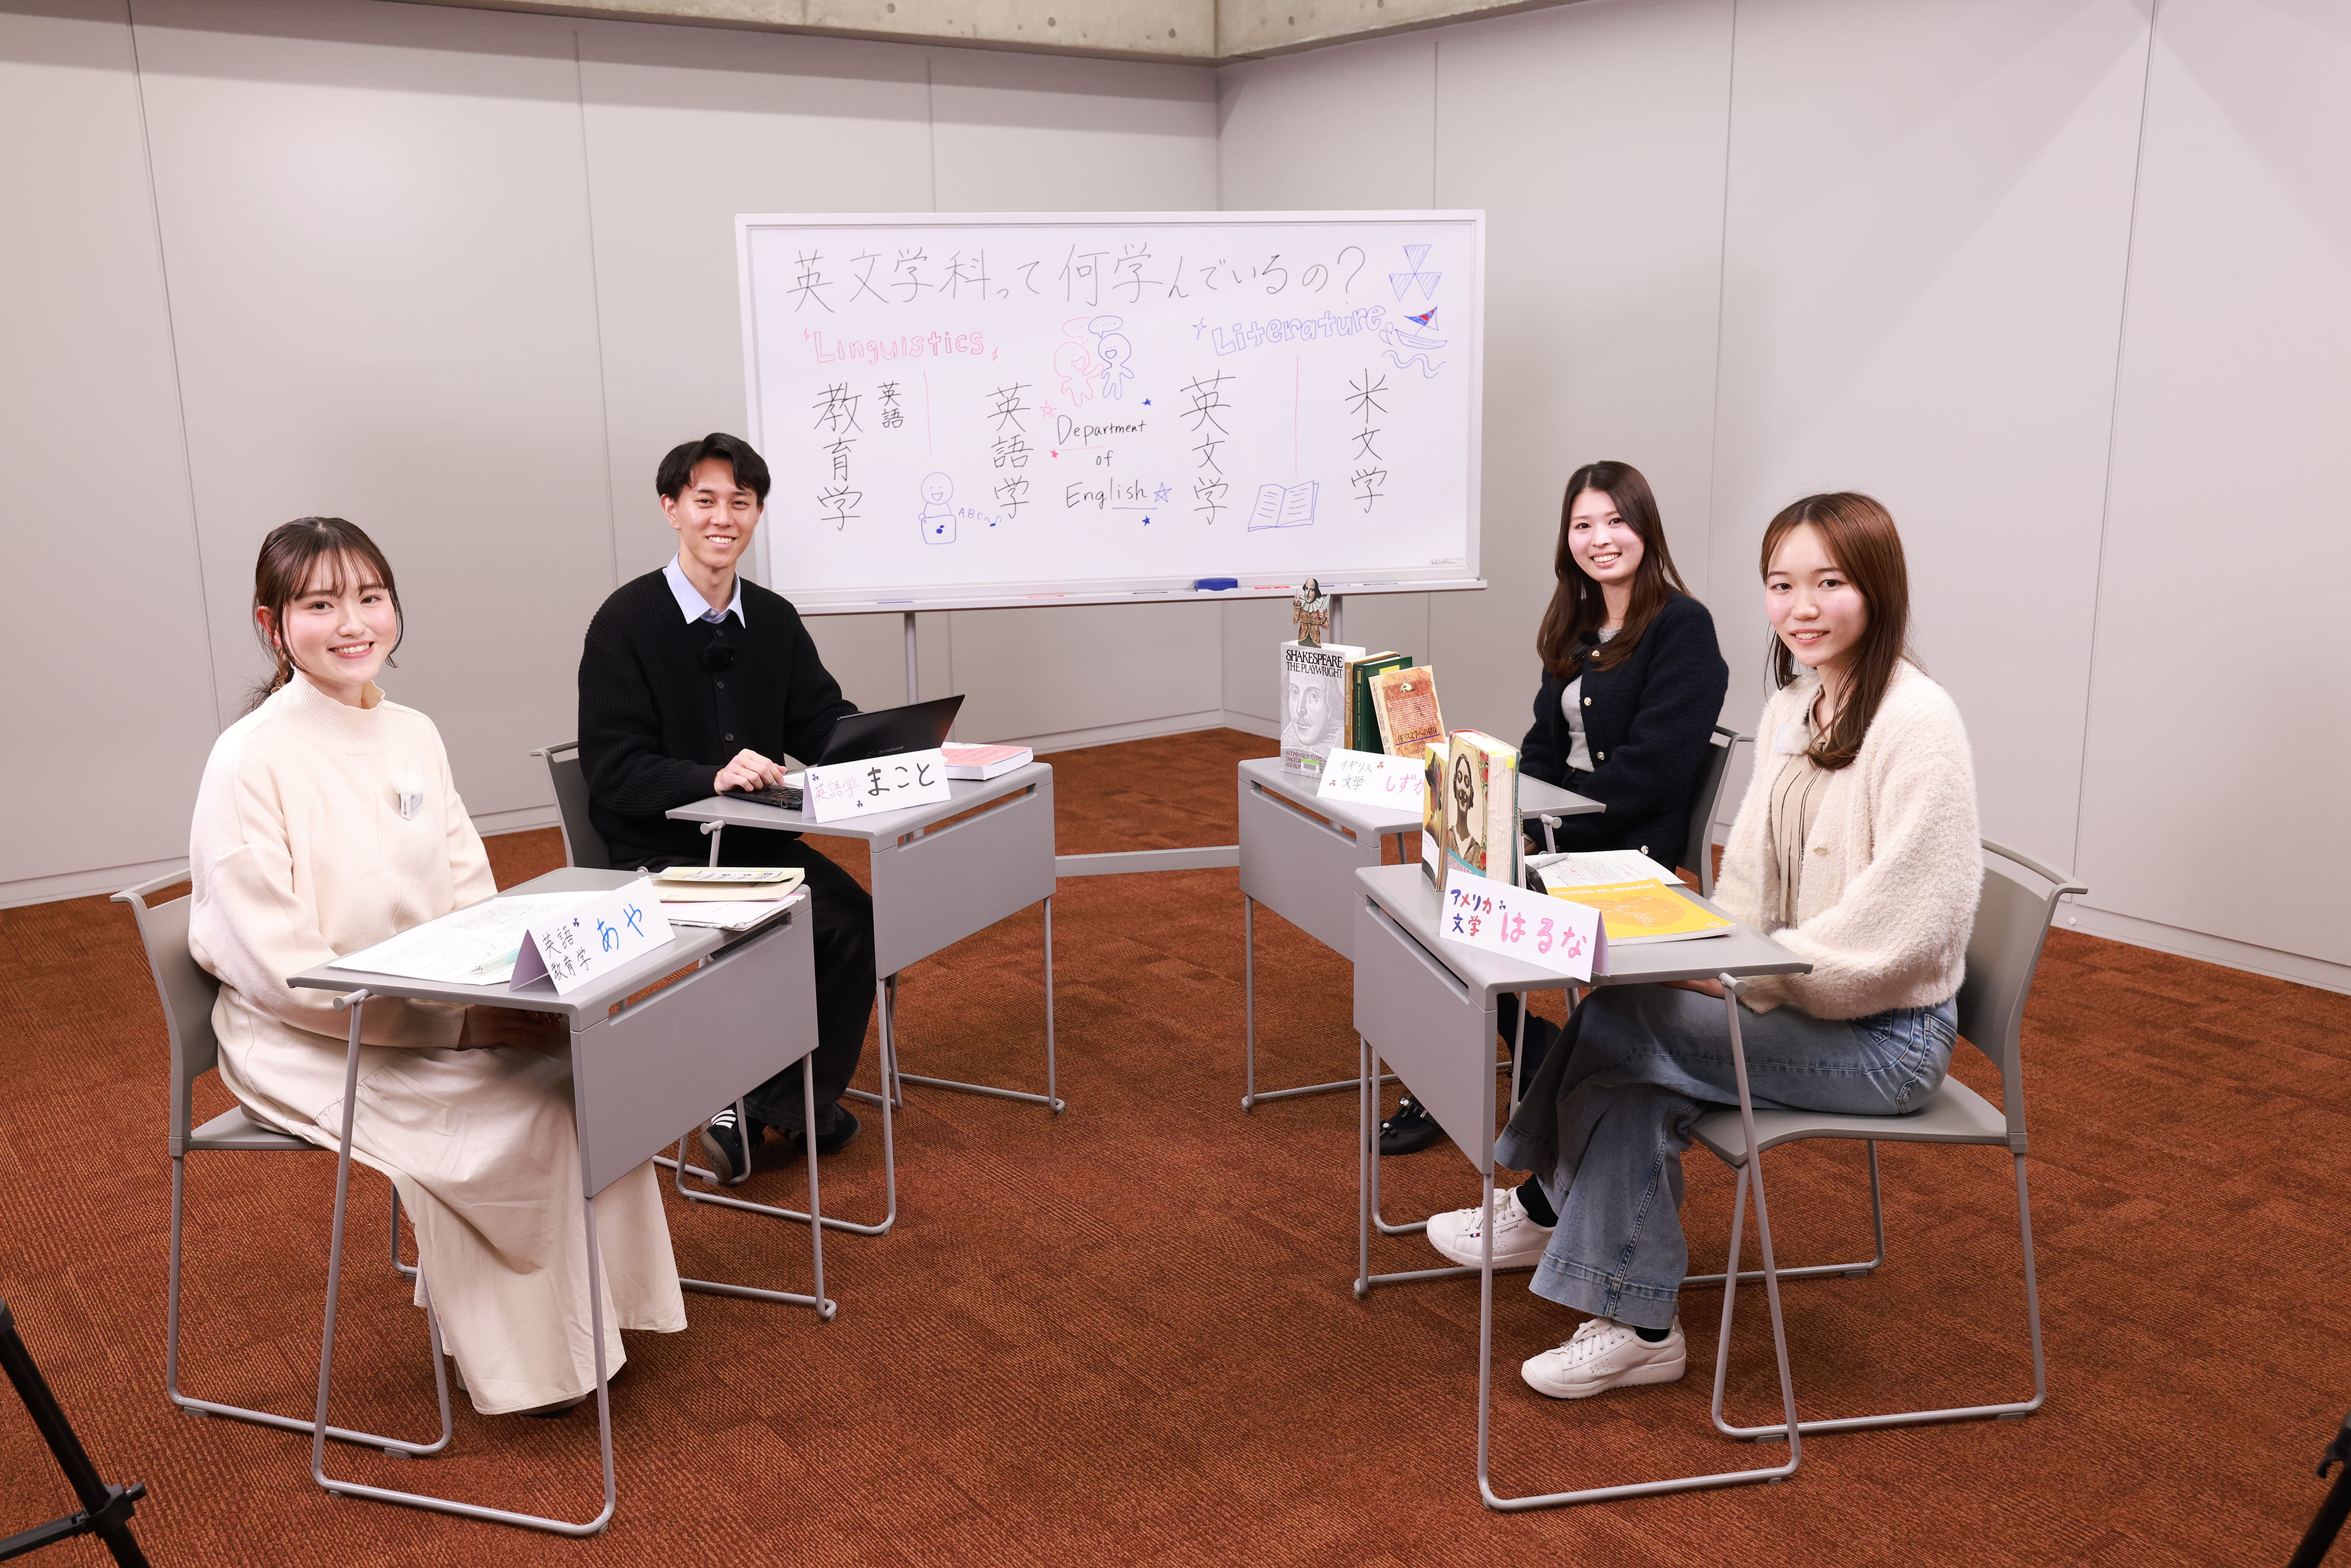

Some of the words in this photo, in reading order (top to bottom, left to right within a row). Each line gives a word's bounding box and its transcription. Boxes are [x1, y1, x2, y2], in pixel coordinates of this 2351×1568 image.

[1212, 305, 1386, 356] Literature
[813, 331, 984, 364] Linguistics
[877, 381, 905, 429] 英語
[1057, 414, 1147, 446] Department
[1344, 368, 1388, 514] 米文学
[812, 381, 863, 531] 教育学
[986, 382, 1034, 519] 英語学
[1096, 450, 1114, 467] of
[1180, 369, 1236, 525] 英文学
[1066, 477, 1149, 510] English
[1286, 649, 1343, 669] SHAKESPEARE
[1286, 661, 1301, 672] THE
[1301, 663, 1343, 678] PLAYWRIGHT
[878, 745, 905, 754] dynabook
[1340, 759, 1372, 773] イギリス
[814, 778, 861, 801] 英語学
[867, 763, 935, 797] まこと
[1342, 774, 1364, 790] 文学
[1450, 888, 1492, 915] アメリカ
[542, 925, 574, 957] 英語
[596, 903, 643, 953] あや
[1452, 913, 1482, 937] 文学
[1500, 911, 1588, 959] はるな
[550, 948, 592, 982] 教育学
